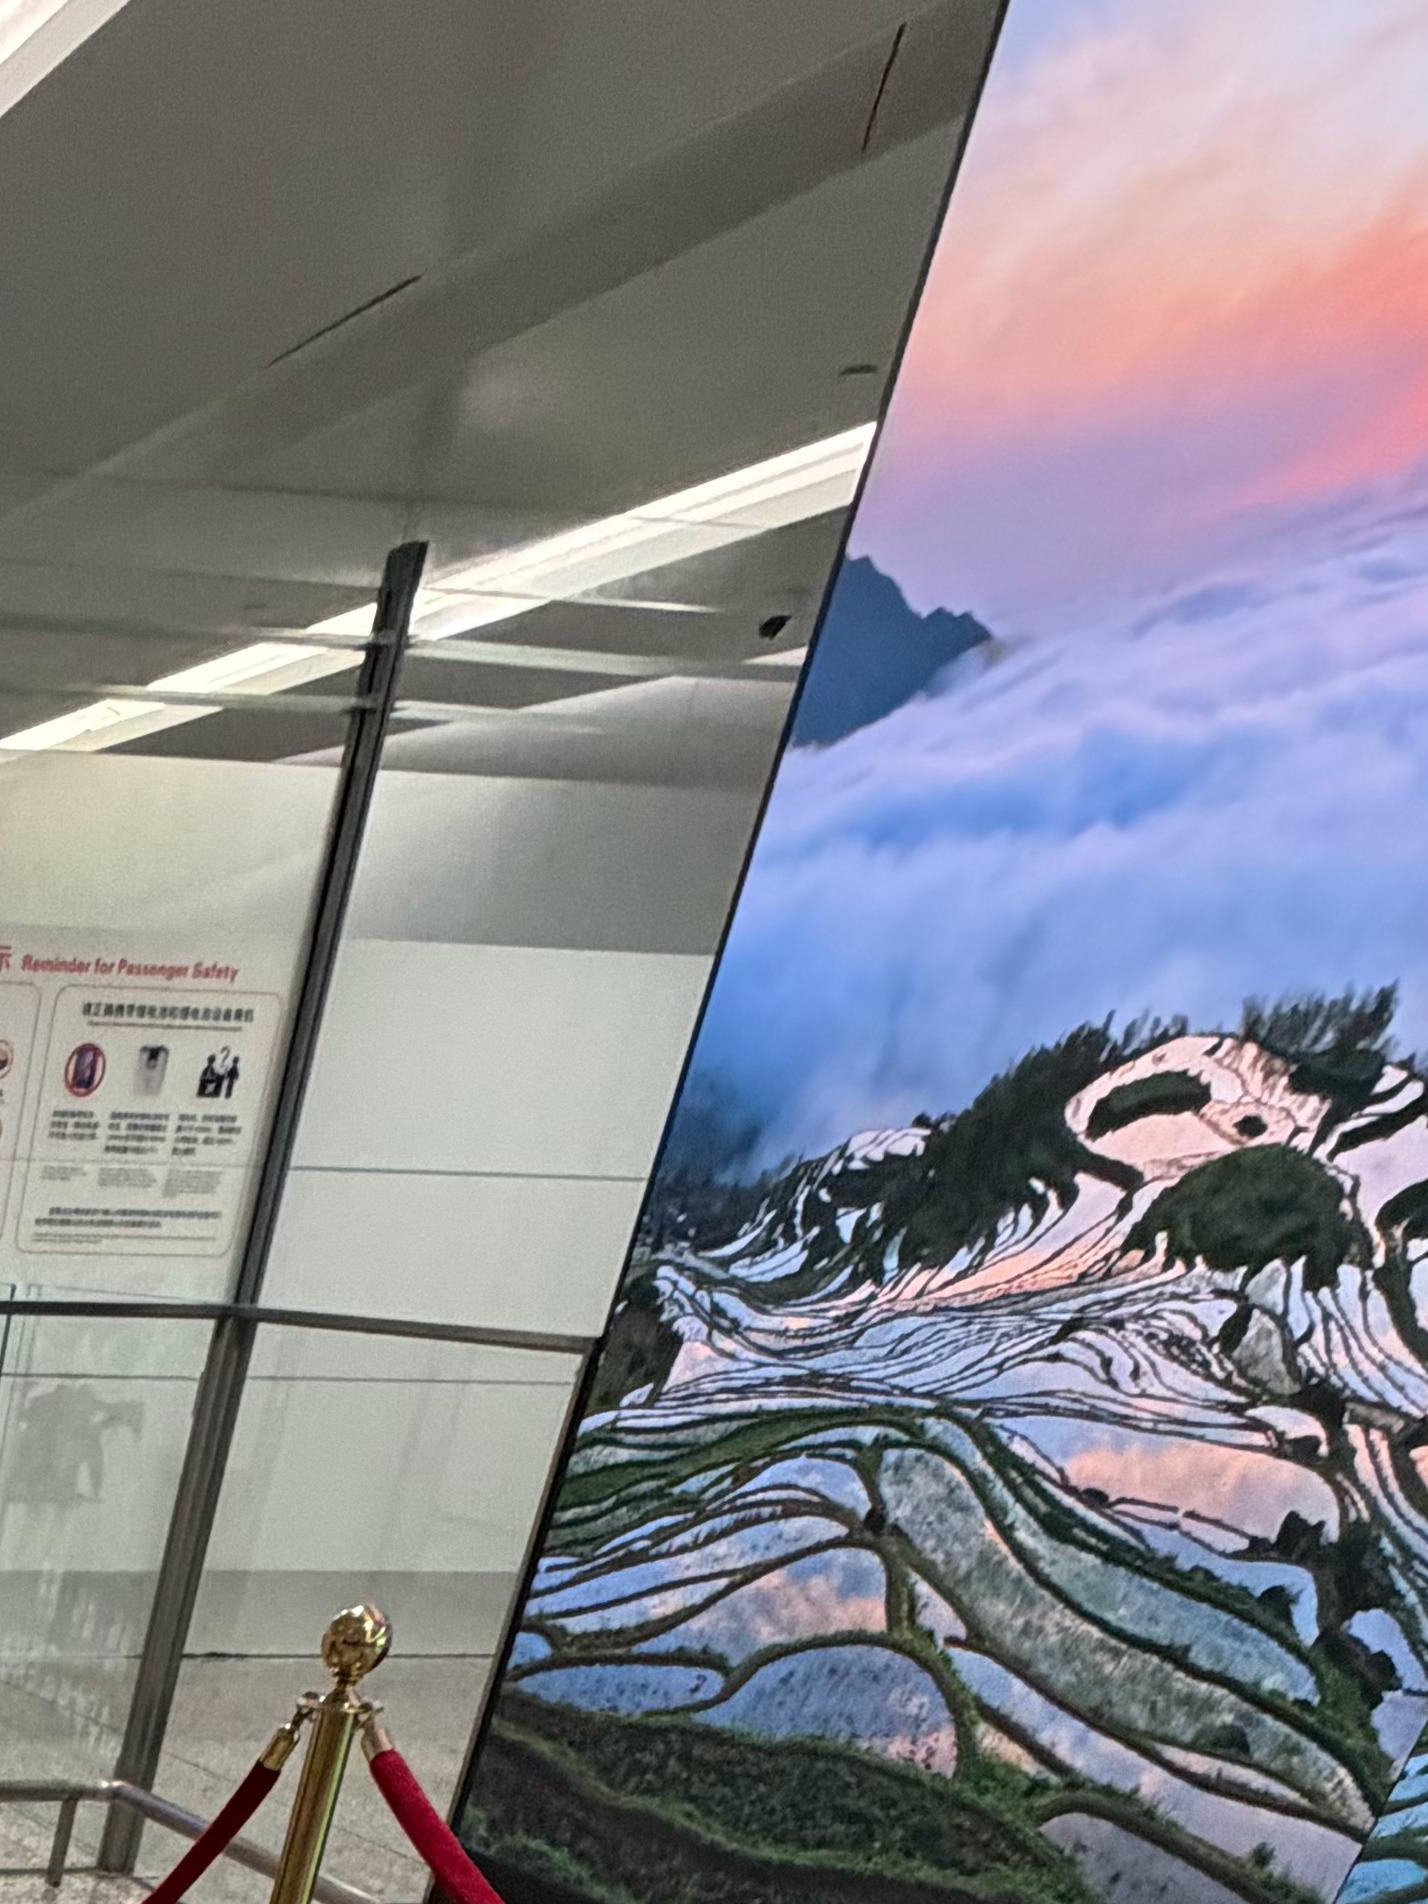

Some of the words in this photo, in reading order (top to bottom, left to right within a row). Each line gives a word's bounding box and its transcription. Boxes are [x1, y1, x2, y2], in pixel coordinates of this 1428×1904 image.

[21, 953, 91, 974] Reminder
[94, 957, 115, 975] for
[116, 957, 189, 982] Passenger
[191, 960, 238, 983] Safety
